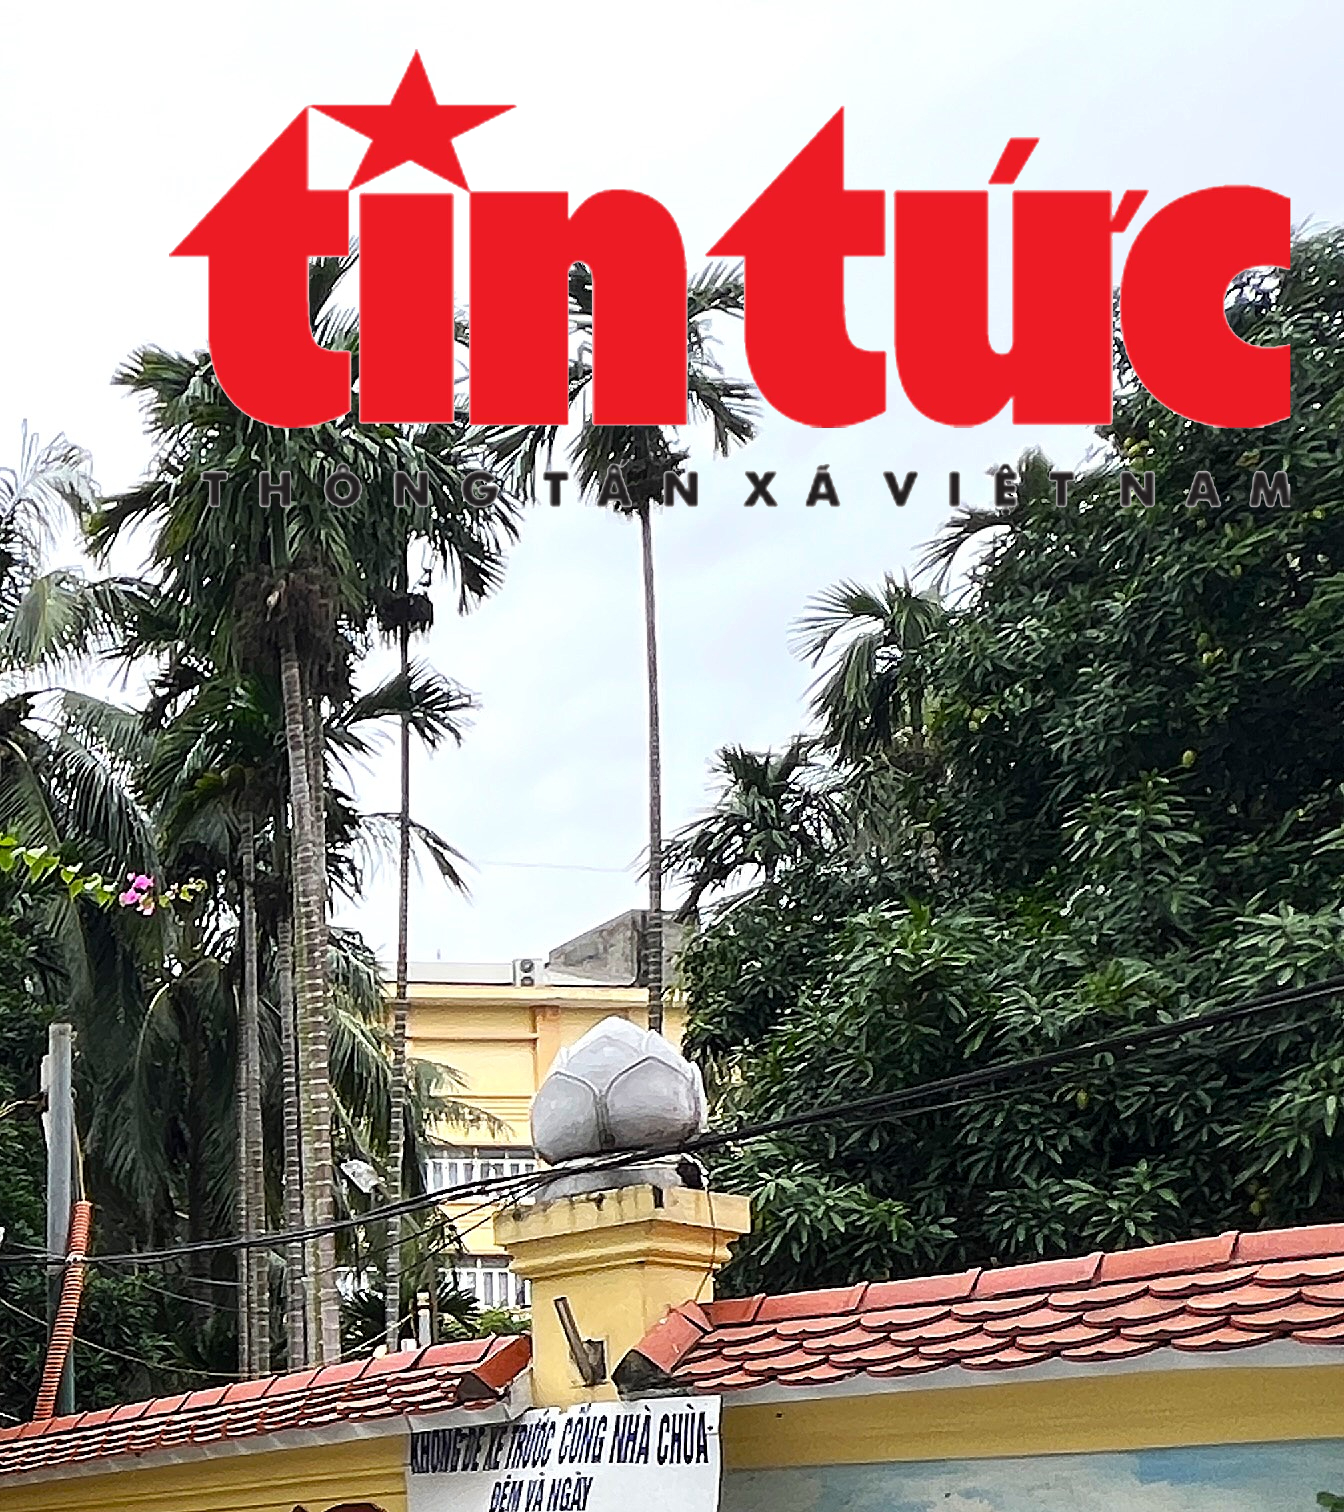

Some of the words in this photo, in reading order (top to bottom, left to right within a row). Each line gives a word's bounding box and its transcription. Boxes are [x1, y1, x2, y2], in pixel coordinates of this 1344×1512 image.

[505, 1409, 556, 1470] TRƯỚC
[609, 1405, 652, 1464] NHÀ
[657, 1404, 710, 1465] CHÙA
[524, 1472, 546, 1512] VÀ
[546, 1471, 594, 1512] NGÀY
